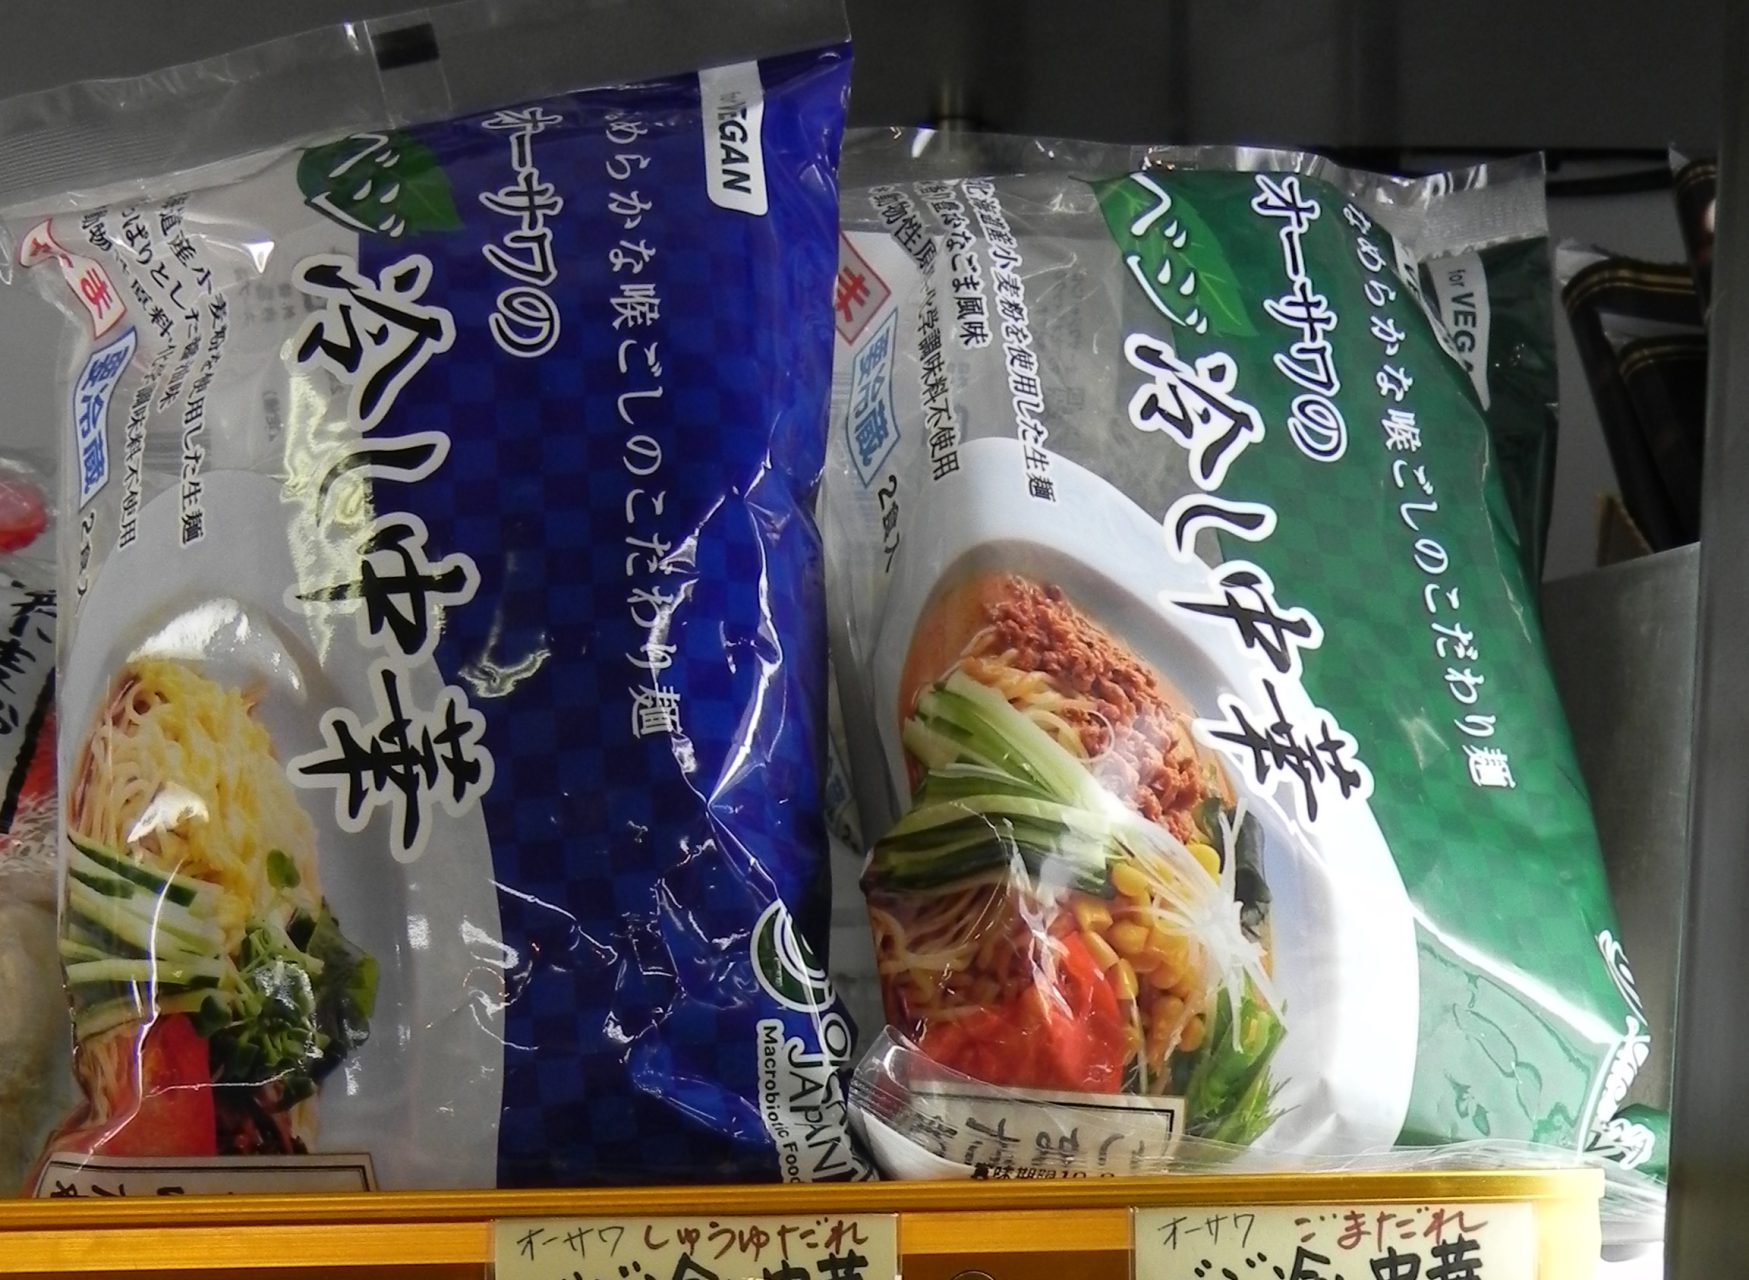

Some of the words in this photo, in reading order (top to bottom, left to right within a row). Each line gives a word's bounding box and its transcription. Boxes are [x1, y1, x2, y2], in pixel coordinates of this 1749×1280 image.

[305, 133, 405, 237] ベジ
[482, 107, 562, 357] オーサワの
[1126, 172, 1208, 334] ベジ
[1251, 173, 1347, 462] オーサワの
[293, 260, 487, 856] 冷し中華
[1130, 339, 1368, 826] 冷し中華
[763, 1025, 790, 1139] Macrobiotic
[517, 1227, 625, 1259] オーサワ
[1158, 1213, 1254, 1250] オーサワ
[1295, 1208, 1489, 1252] ごまだれ
